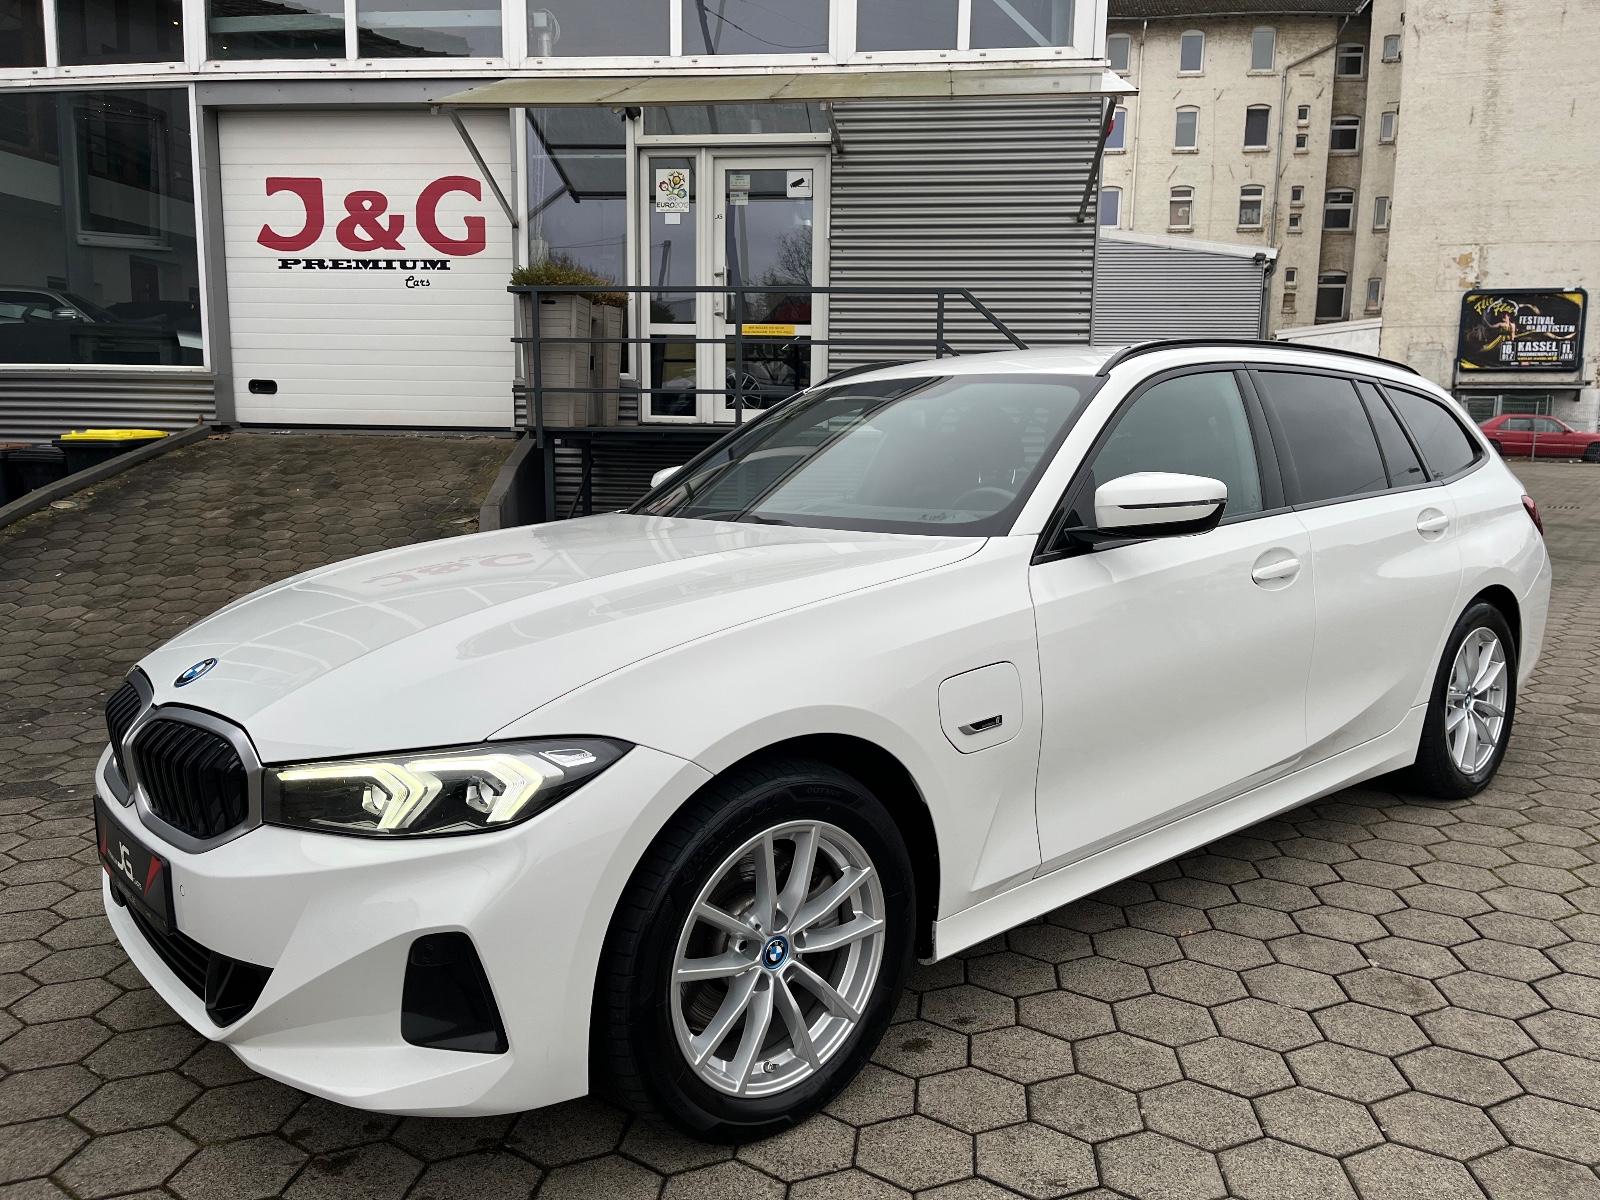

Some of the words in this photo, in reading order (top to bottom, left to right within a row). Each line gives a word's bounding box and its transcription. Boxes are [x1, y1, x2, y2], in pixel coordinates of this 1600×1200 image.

[256, 175, 486, 257] J&G
[278, 258, 451, 271] PREMIUM
[404, 275, 431, 289] Cars
[1519, 315, 1555, 325] FESTIVAL
[1536, 325, 1576, 333] ARTISTEN
[1517, 341, 1559, 352] KASSEL
